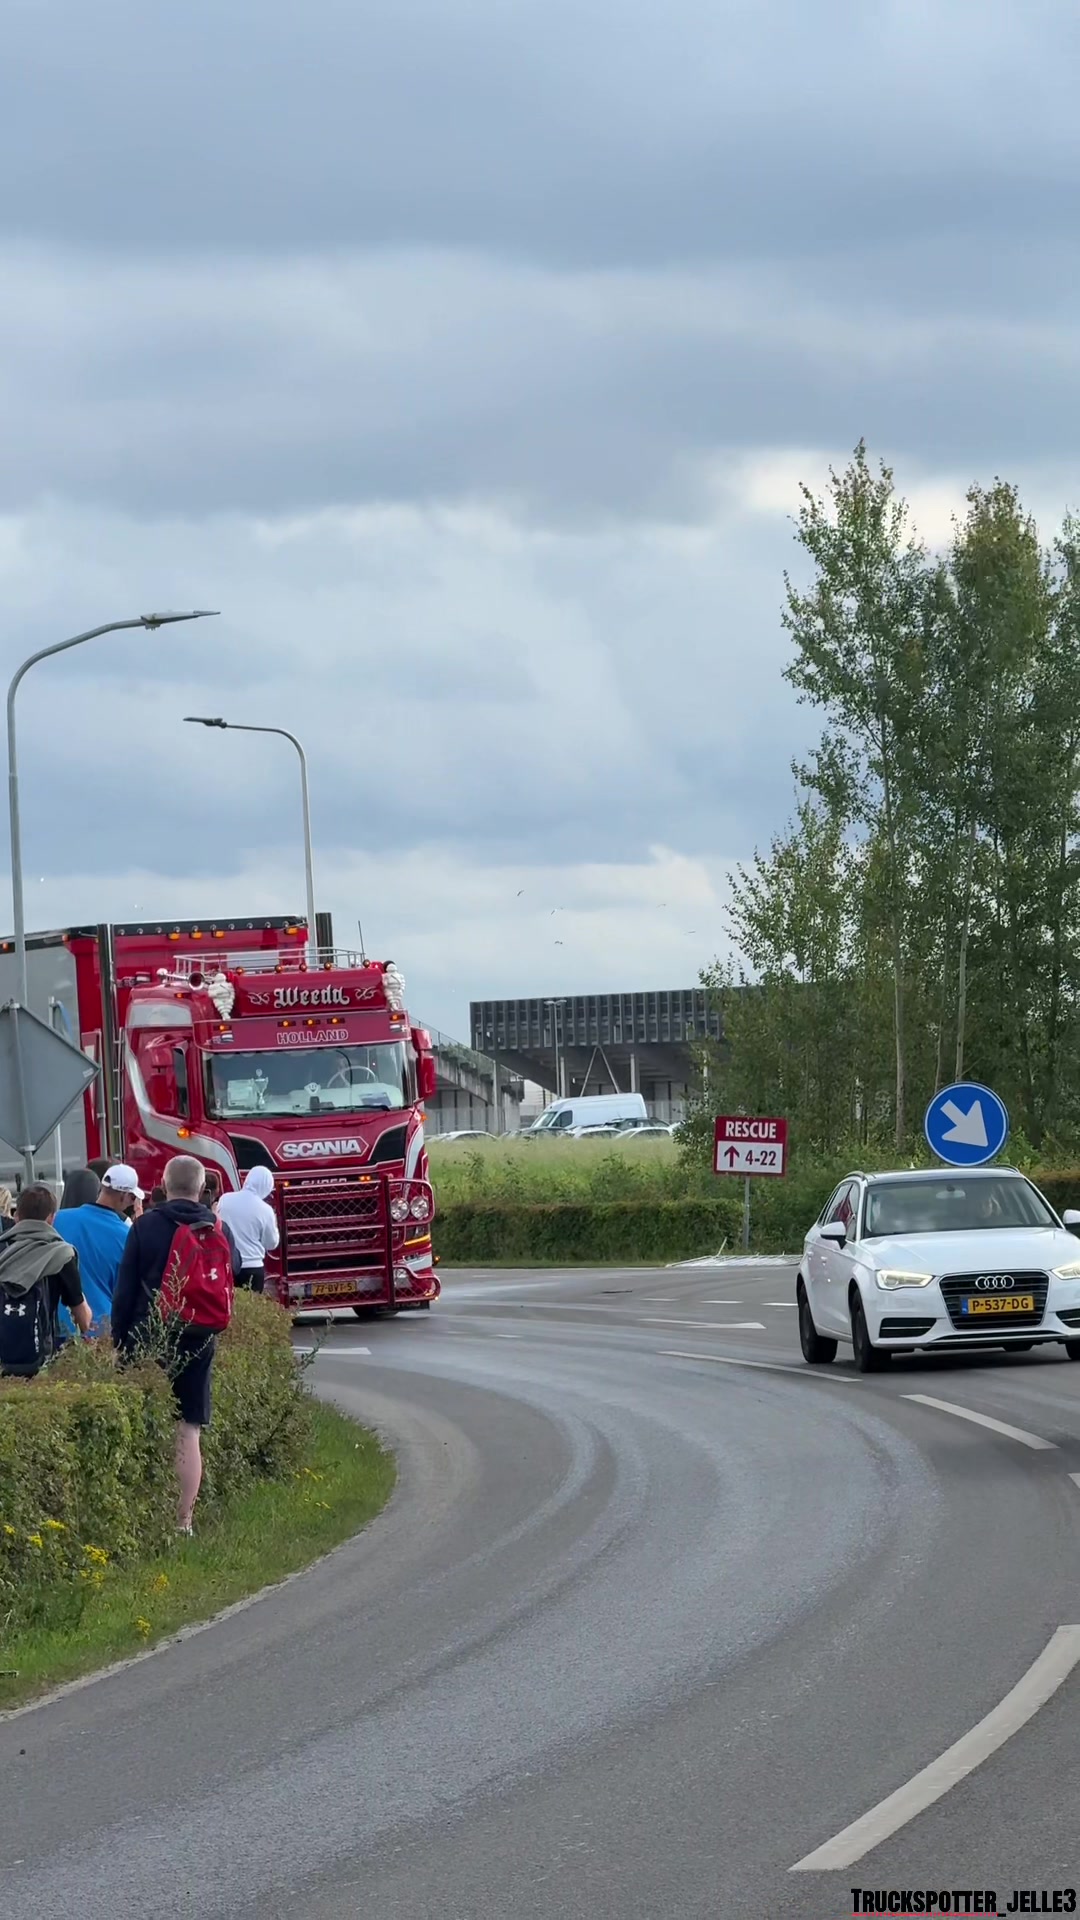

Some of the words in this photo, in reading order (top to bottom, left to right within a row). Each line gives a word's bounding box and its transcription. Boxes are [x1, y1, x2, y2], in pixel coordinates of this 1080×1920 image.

[273, 984, 350, 1008] Weeda
[277, 1029, 348, 1044] HOLLAND
[725, 1121, 777, 1139] RESCUE
[282, 1140, 361, 1157] SCANIA
[745, 1149, 777, 1167] 4-22
[972, 1298, 1029, 1311] P-537-DG
